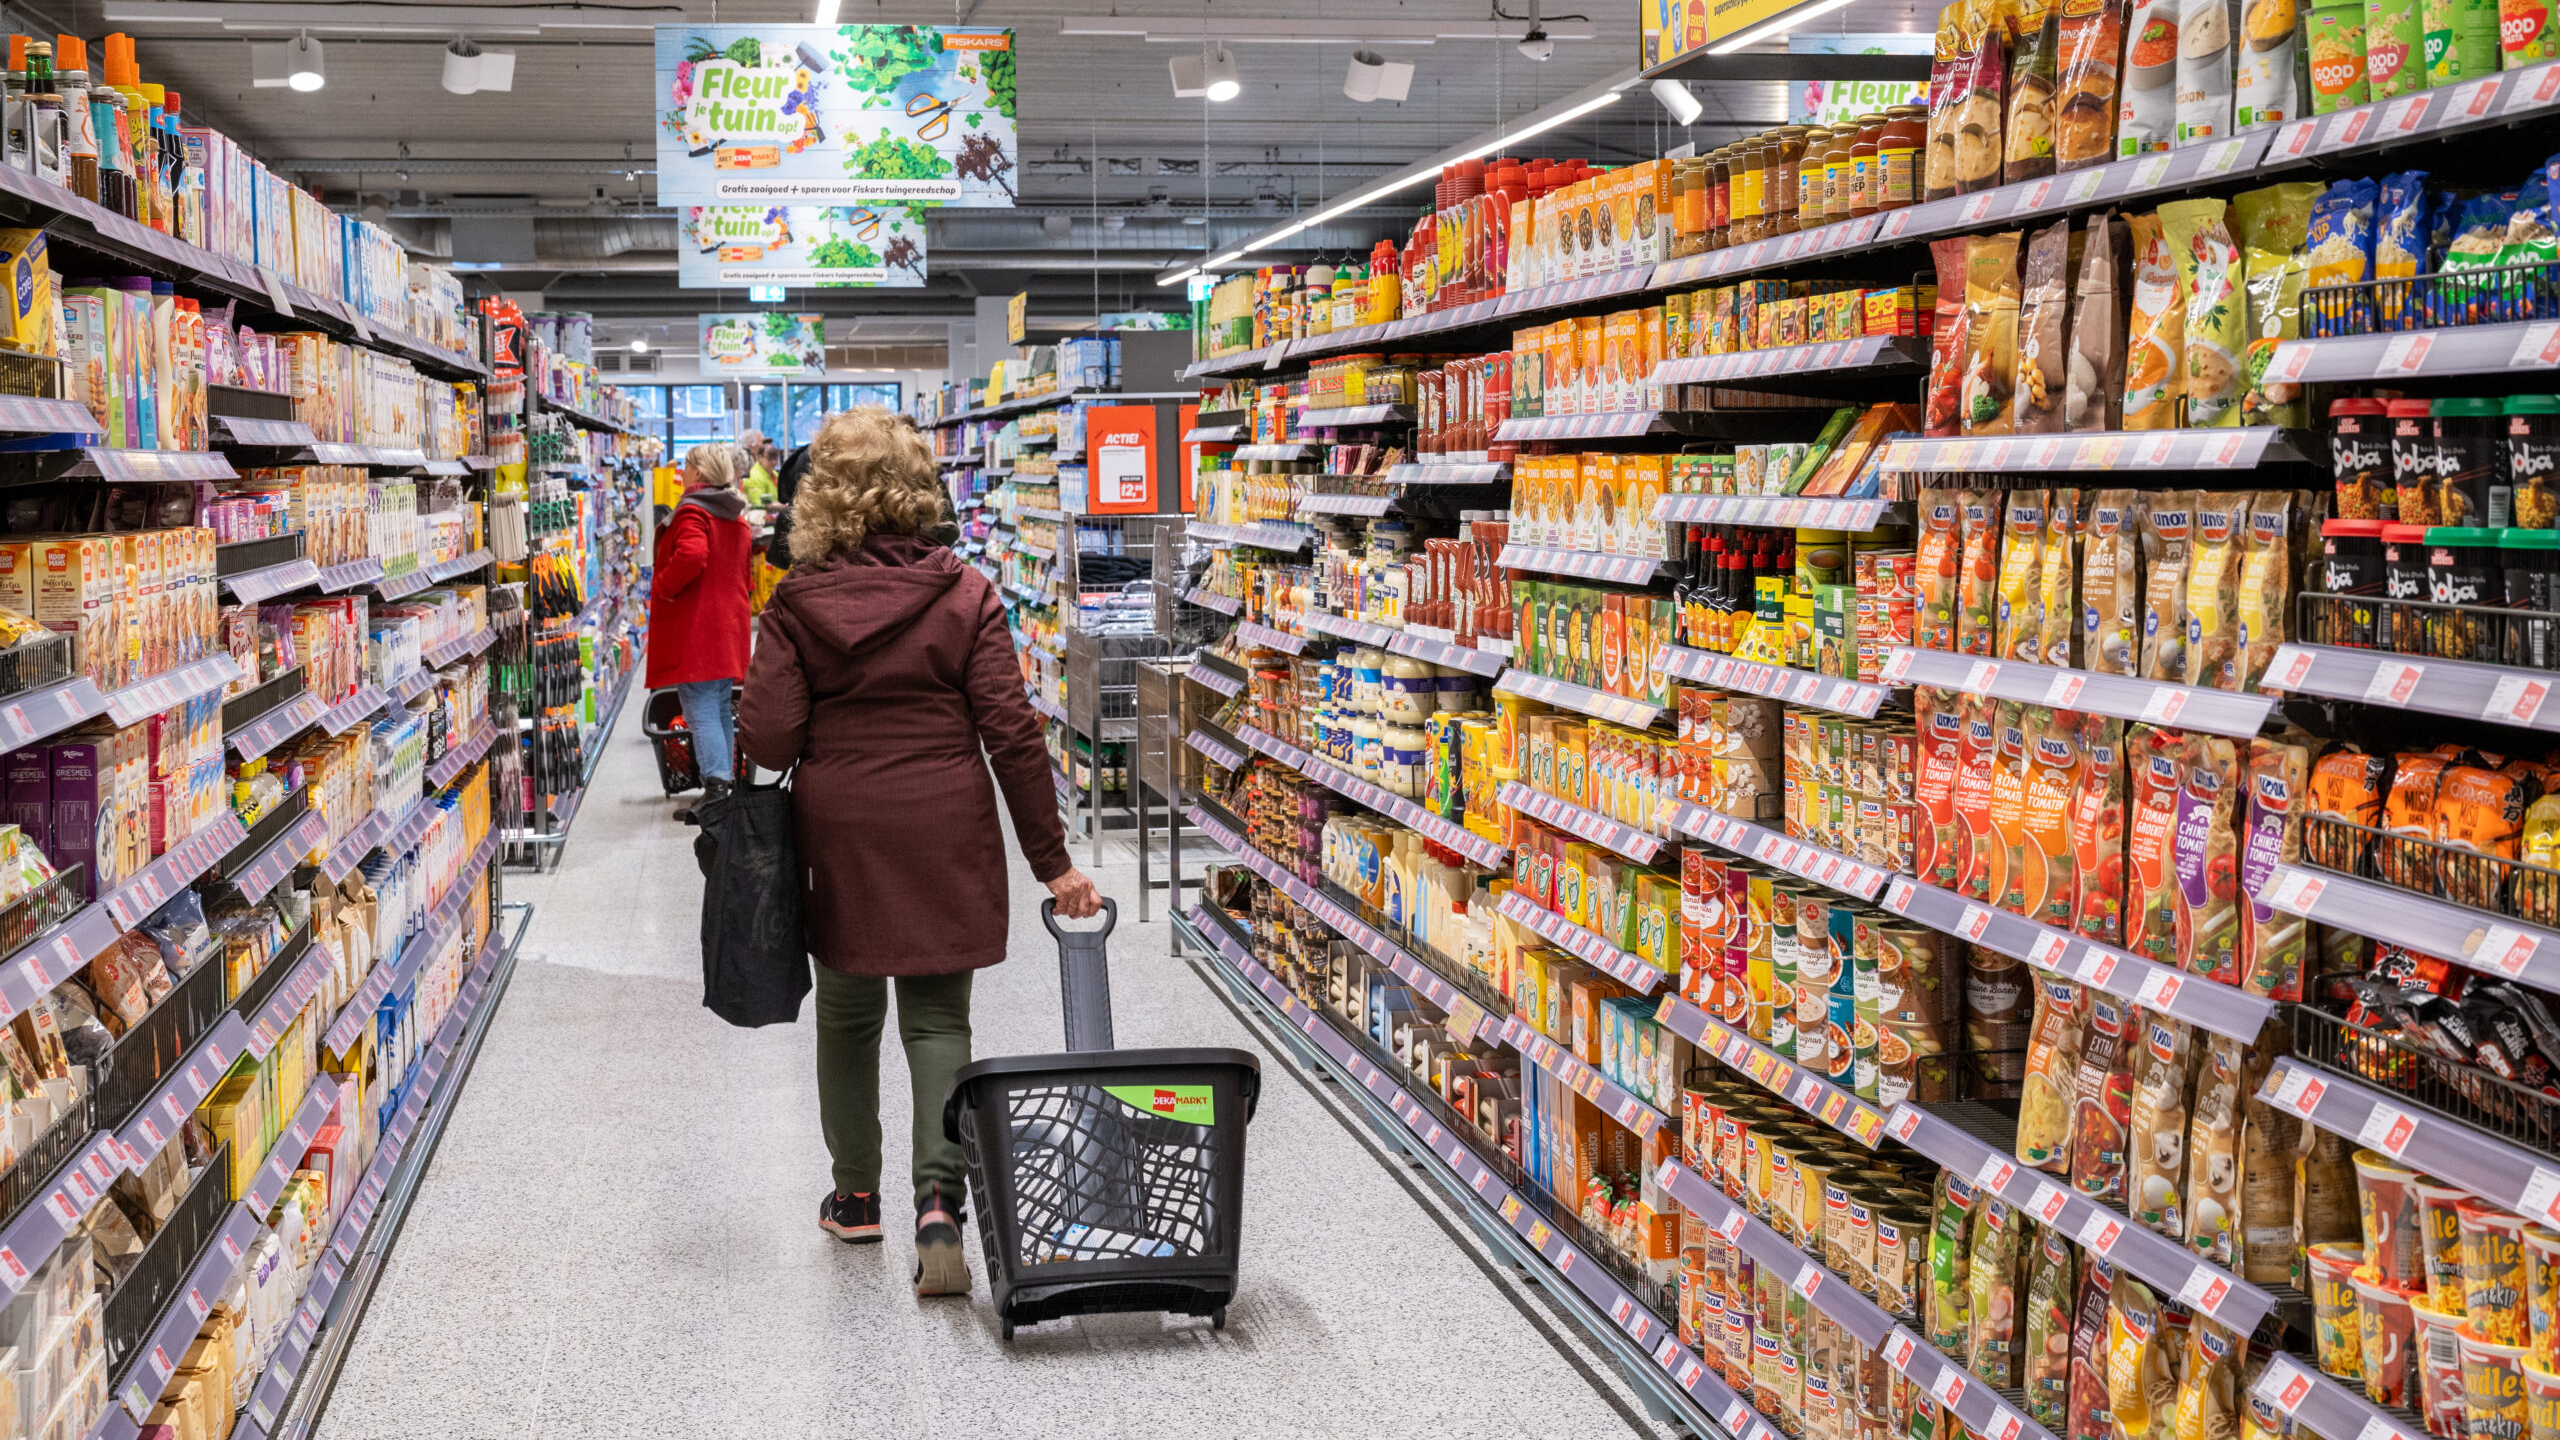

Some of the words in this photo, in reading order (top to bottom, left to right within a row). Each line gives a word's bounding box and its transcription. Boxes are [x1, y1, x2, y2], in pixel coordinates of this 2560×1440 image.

[1689, 14, 1704, 27] LEKKER
[946, 37, 1004, 47] FISKARS
[1691, 28, 1702, 41] LAAG
[2314, 64, 2354, 80] GOOD
[702, 67, 789, 99] Fleur
[2321, 77, 2343, 87] PASTA
[1831, 81, 1911, 105] Fleur
[695, 102, 707, 118] je
[708, 100, 776, 133] tuin
[777, 120, 798, 134] op!
[1825, 110, 1835, 123] je
[718, 155, 733, 163] MET
[1613, 182, 1633, 195] HONIG
[1636, 175, 1653, 188] HONIG
[722, 185, 749, 194] Gratis
[750, 184, 788, 196] zaaigoed
[801, 186, 829, 196] sparen
[852, 185, 884, 194] Fiskars
[885, 185, 956, 196] tuingereedschap
[705, 218, 713, 227] je
[714, 214, 760, 237] tuin
[2311, 222, 2330, 242] KIP
[18, 277, 32, 299] care
[1620, 325, 1636, 336] HONIG
[1105, 433, 1139, 444] ACTIE!
[2333, 438, 2381, 478] Soba
[2392, 439, 2438, 480] Soba
[2436, 446, 2460, 476] ba
[1543, 469, 1558, 478] HONIG
[1560, 469, 1574, 479] HONIG
[1625, 469, 1637, 480] HONI
[1639, 470, 1658, 481] HONIG
[2153, 512, 2187, 527] unox
[2326, 562, 2352, 590] oba
[2389, 569, 2419, 599] oba
[1961, 766, 1992, 780] KLASSIE
[1995, 774, 2022, 788] ROMI
[1993, 787, 2022, 801] TOMATE
[2029, 782, 2072, 798] ROMIGE
[2028, 796, 2065, 811] TOMATEN
[2141, 808, 2169, 823] TOMAAT
[2136, 821, 2165, 838] GROENTE
[2253, 833, 2283, 850] CHINESE
[2249, 848, 2280, 866] TOMATEN
[1989, 985, 2018, 995] Bonen
[2089, 1035, 2114, 1056] EXTRA
[1153, 1095, 1208, 1106] DEKAMARKT
[1772, 1154, 1786, 1166] nox
[1950, 1176, 1971, 1198] unox
[1850, 1204, 1867, 1219] nox
[1879, 1224, 1897, 1239] nox
[2462, 1235, 2525, 1267] oodles
[2527, 1255, 2558, 1287] les
[1726, 1314, 1741, 1326] nox
[1782, 1353, 1794, 1366] nox
[2110, 1364, 2137, 1392] KIPPEN
[2465, 1367, 2527, 1397] oodles
